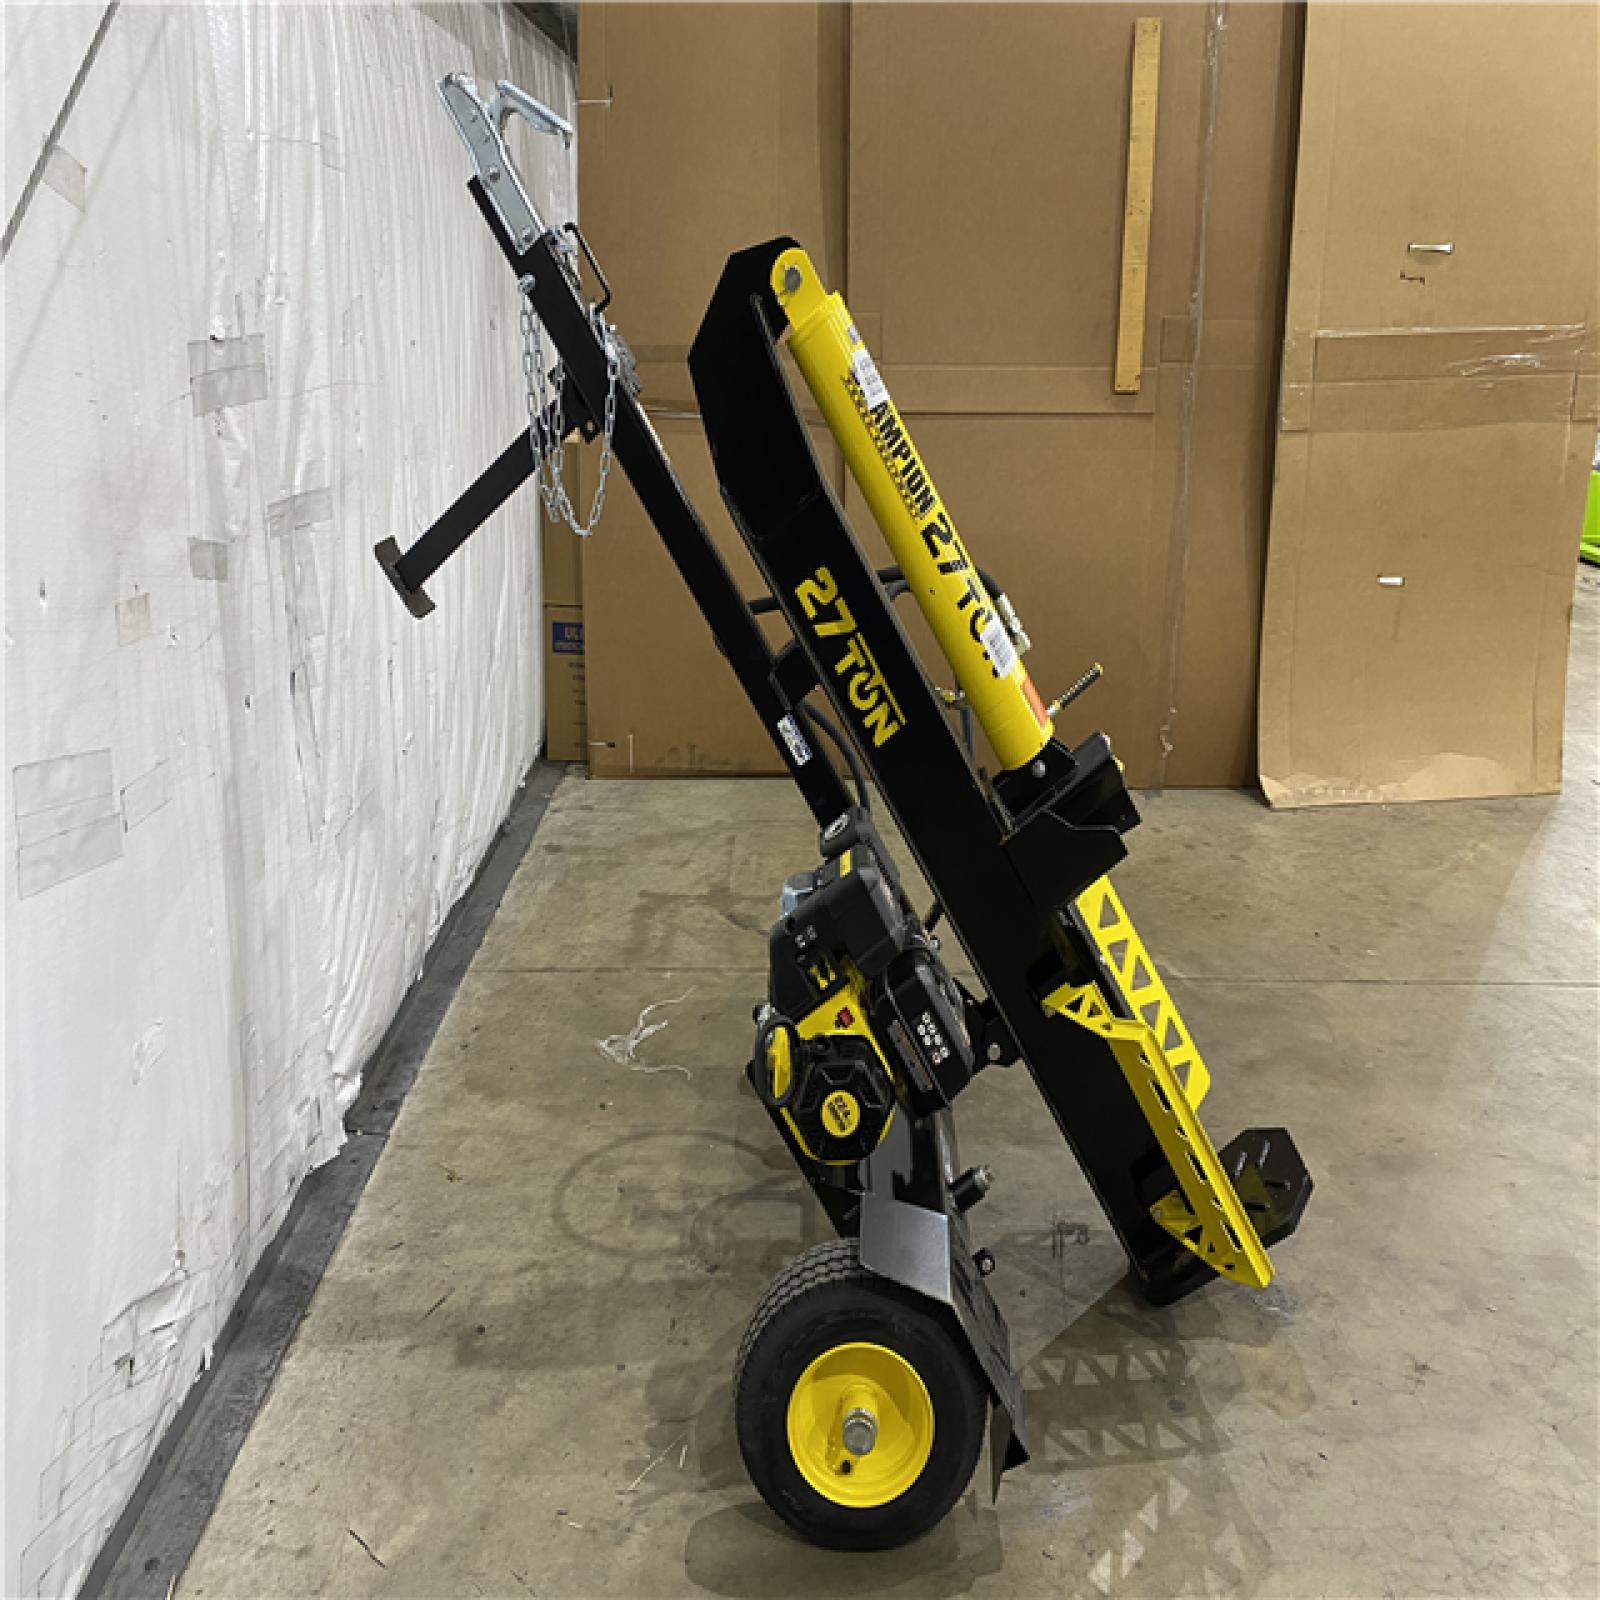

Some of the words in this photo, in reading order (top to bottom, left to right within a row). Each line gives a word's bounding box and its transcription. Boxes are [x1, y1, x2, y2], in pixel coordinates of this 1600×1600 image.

[851, 375, 935, 513] AMPION
[920, 512, 967, 575] 27
[795, 565, 858, 637] 27
[834, 631, 907, 748] TON
